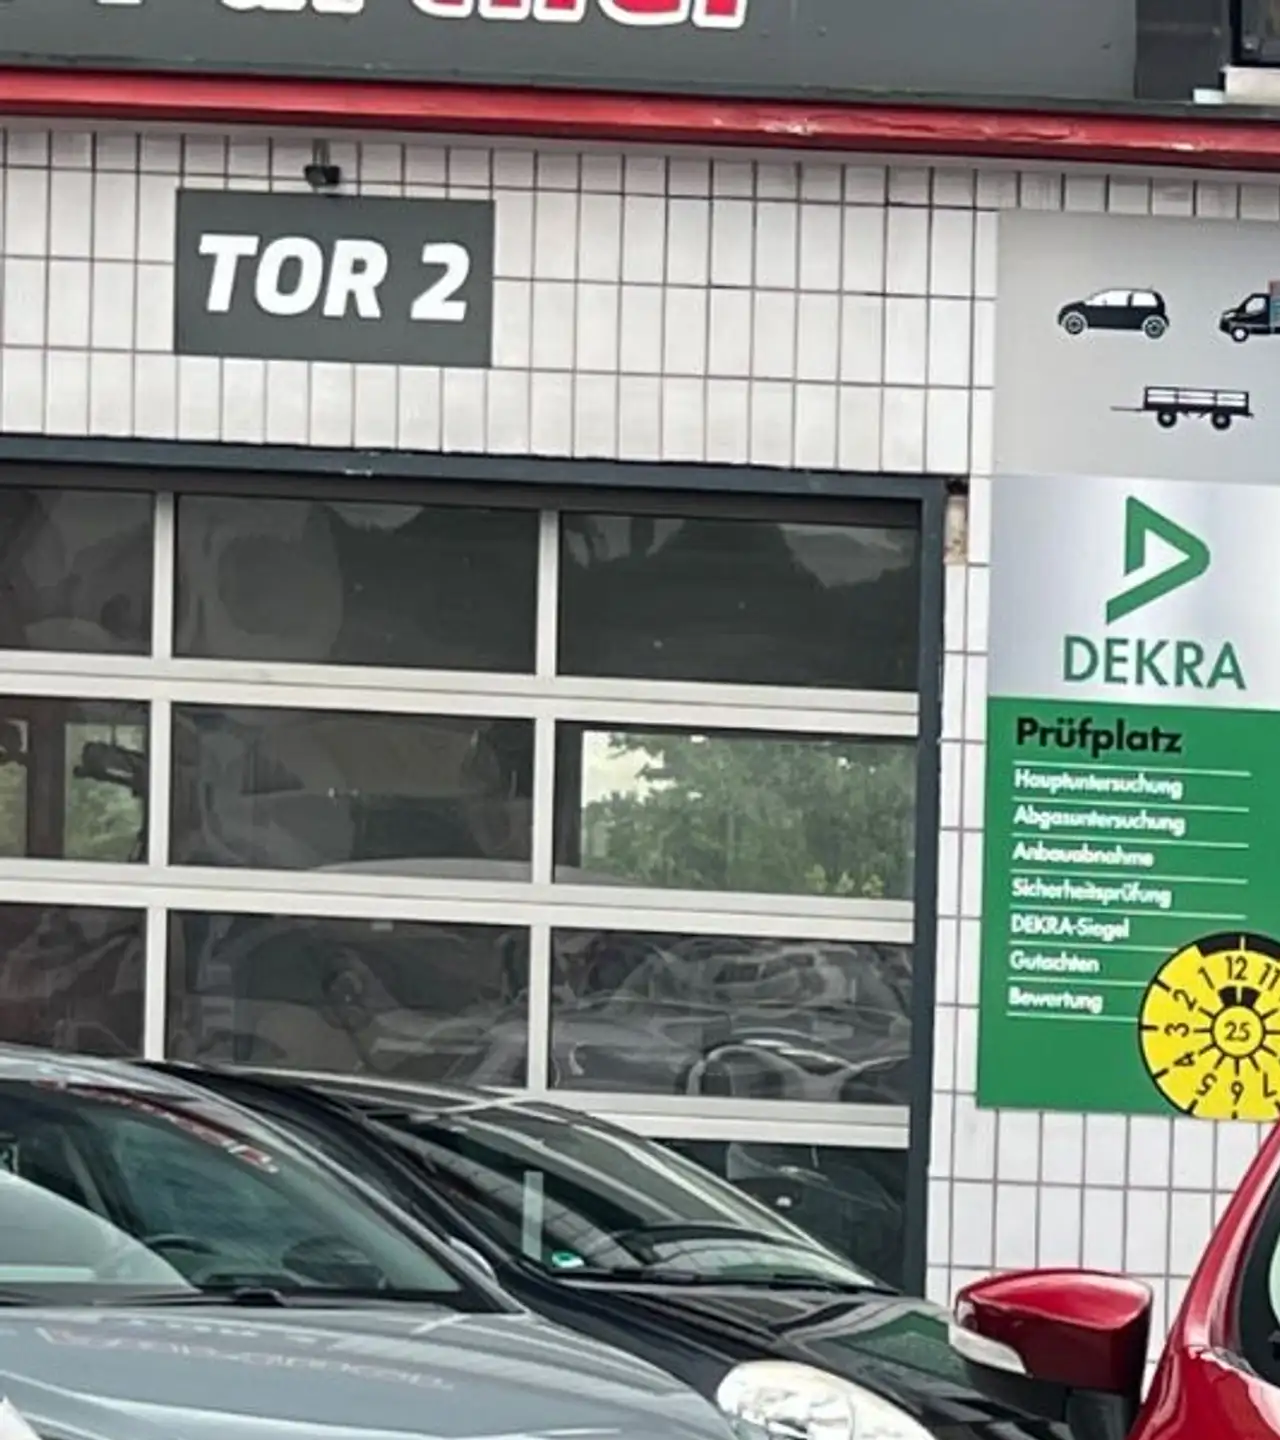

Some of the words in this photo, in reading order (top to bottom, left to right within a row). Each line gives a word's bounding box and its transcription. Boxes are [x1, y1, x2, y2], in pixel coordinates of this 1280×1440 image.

[199, 232, 388, 319] TOR
[411, 241, 469, 322] 2
[1063, 634, 1246, 690] DEKRA
[1016, 717, 1182, 759] Prüfplatz
[1014, 768, 1184, 800] Hauptuntersuchung
[1013, 805, 1186, 836] Abgasuntersuchung
[1012, 841, 1154, 868] Anbauabnahme
[1011, 877, 1172, 909] Sicherheitsprüfung
[1010, 913, 1131, 940] DEKRA-Siegel
[1010, 950, 1100, 974] Gutachten
[1226, 955, 1247, 980] 12
[1008, 988, 1103, 1013] Bewertung
[1173, 988, 1197, 1011] 2
[1164, 1022, 1190, 1037] 3
[1224, 1022, 1251, 1041] 25
